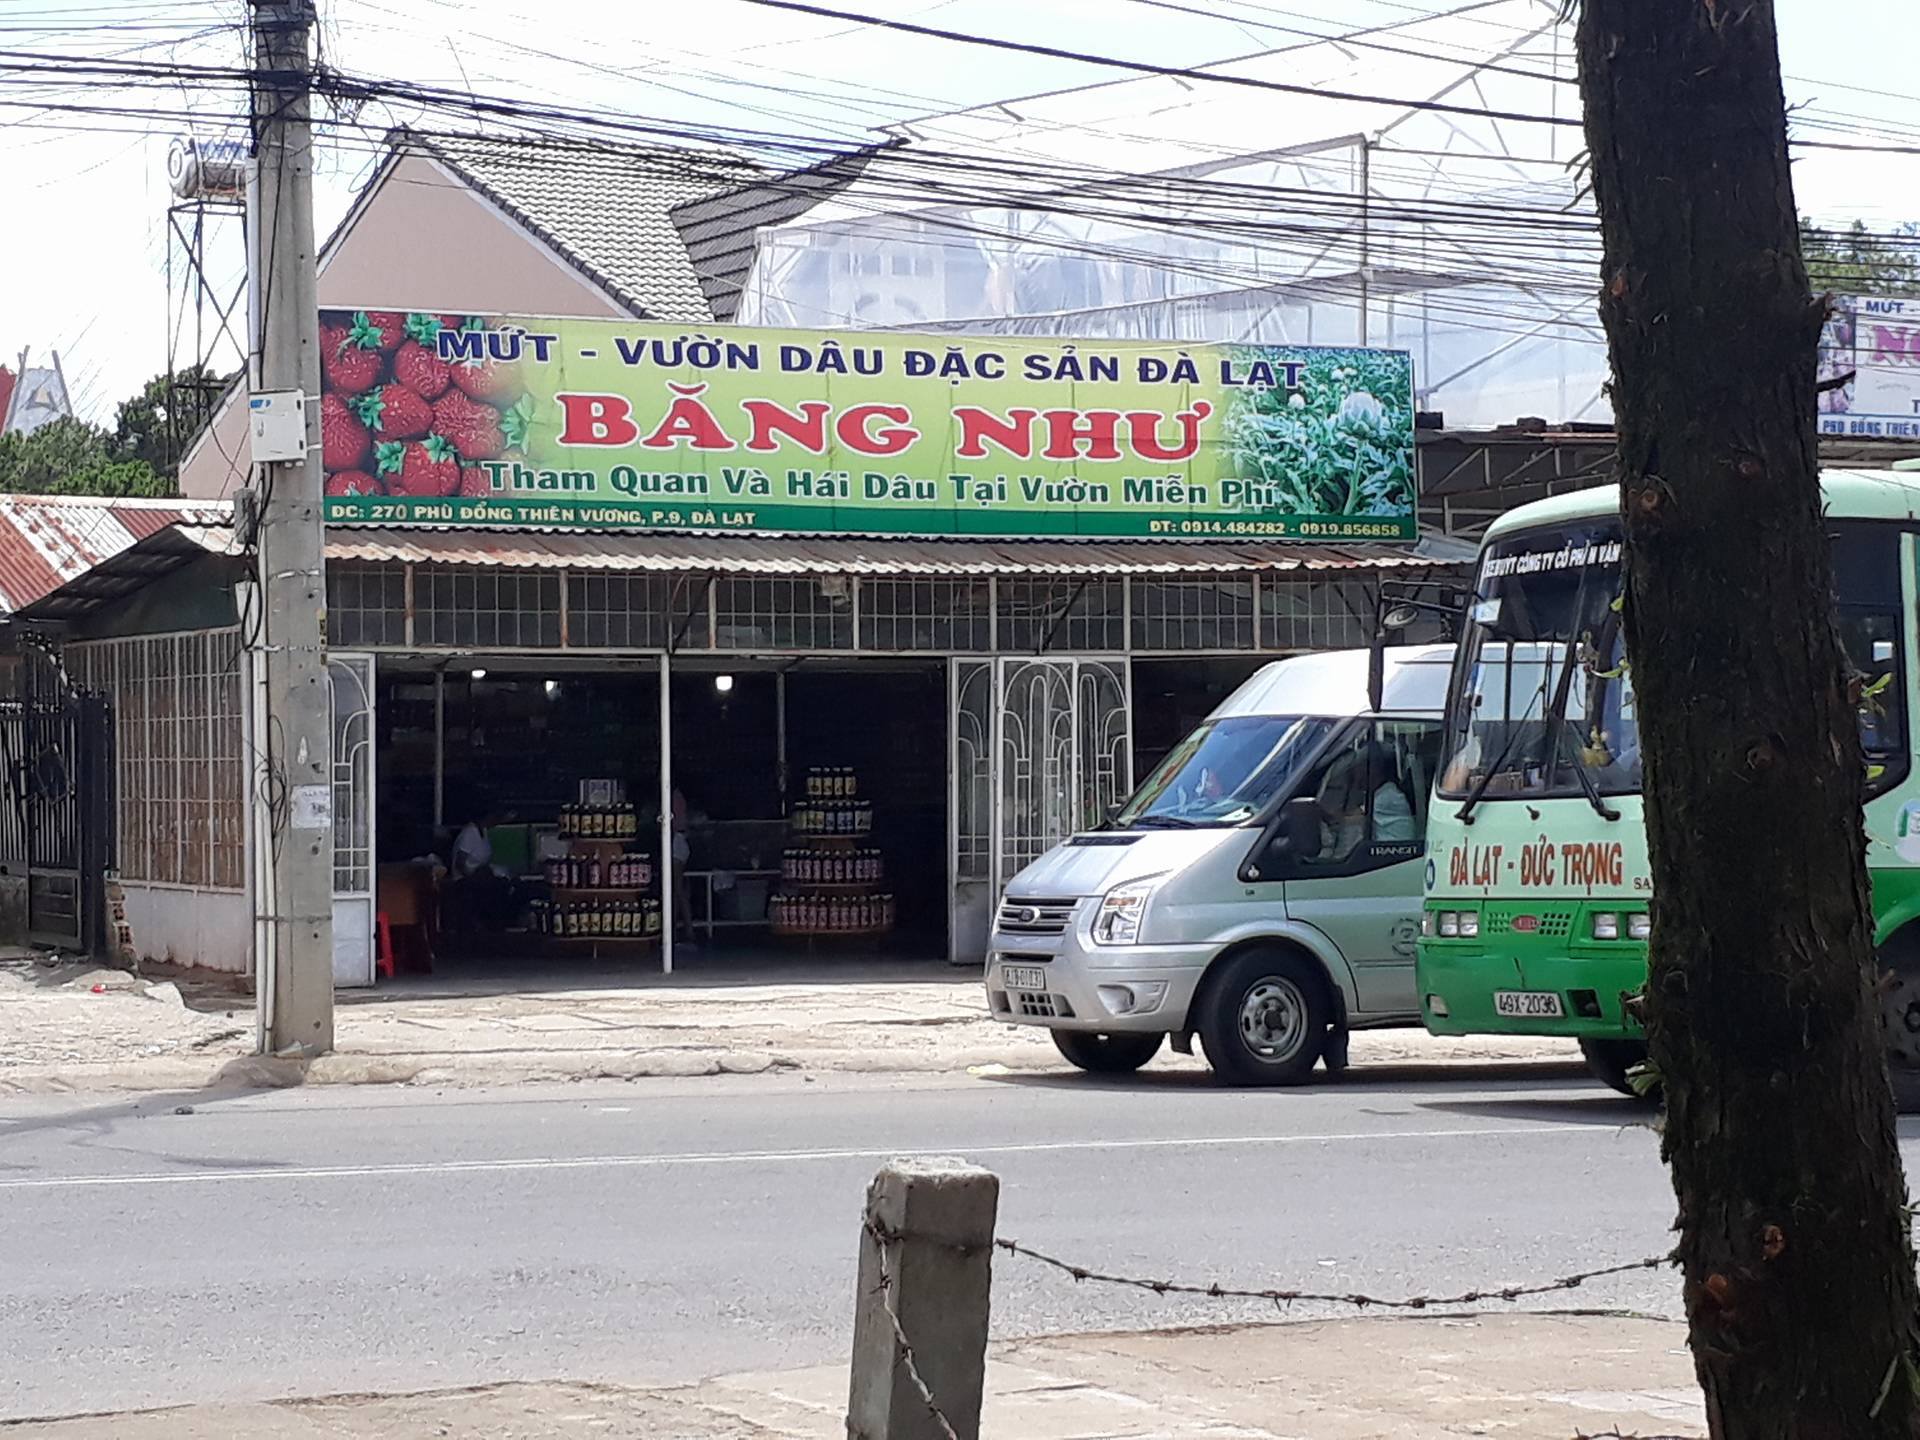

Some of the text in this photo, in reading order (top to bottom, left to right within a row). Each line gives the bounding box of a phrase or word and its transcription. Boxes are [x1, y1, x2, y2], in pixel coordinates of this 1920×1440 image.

[438, 326, 558, 362] MỨT
[614, 334, 760, 370] VƯỜN
[780, 340, 883, 375] DÂU
[903, 346, 1006, 386] ĐẶC
[1023, 345, 1119, 382] SẢN
[1137, 351, 1200, 384] ĐÀ
[1220, 360, 1305, 391] LẠT
[556, 382, 1212, 461] BĂNG NHƯ
[482, 462, 1279, 506] Tham Quan Và Hái Dâu Tại Vườn Miễn Phí
[371, 503, 407, 520] 270
[414, 504, 453, 520] PHÙ
[460, 501, 513, 521] ĐỔNG
[518, 505, 575, 521] THIÊN
[579, 507, 646, 525] VƯƠNG,
[652, 511, 686, 526] P.9,
[691, 509, 716, 525] ĐÀ
[722, 511, 756, 527] LẠT
[1181, 520, 1286, 535] 0914.484282
[1541, 551, 1556, 571] TY
[1370, 845, 1418, 856] TRANSIT
[1473, 845, 1503, 896] LẠT
[1520, 833, 1555, 887] ĐỨC
[1561, 842, 1623, 896] TRỌNG
